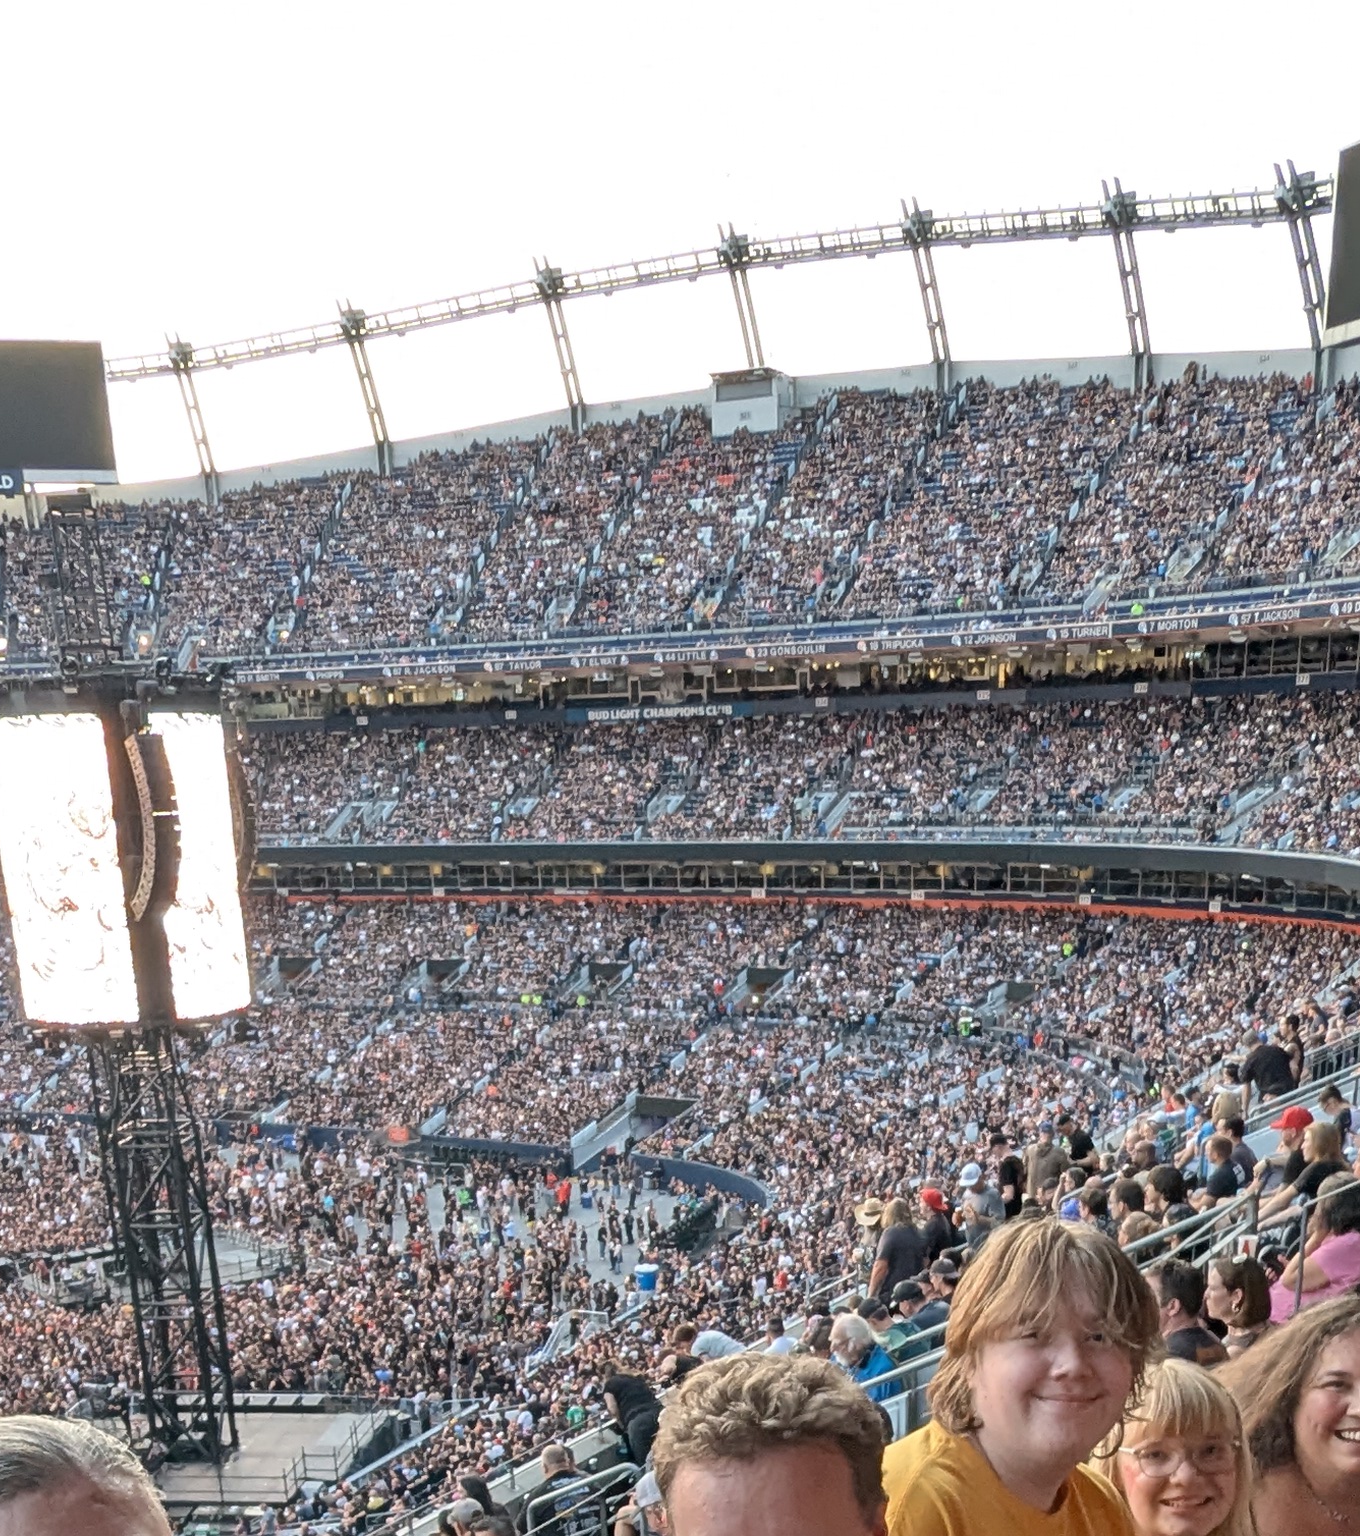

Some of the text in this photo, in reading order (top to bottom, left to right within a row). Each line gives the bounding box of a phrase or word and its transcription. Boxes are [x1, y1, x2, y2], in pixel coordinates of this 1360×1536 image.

[1341, 602, 1353, 613] 49
[1241, 615, 1252, 625] 57
[1261, 608, 1301, 622] JACKSON
[1156, 619, 1199, 631] MORTON
[1072, 626, 1109, 638] TURNER
[964, 632, 1017, 644] 12 JOHNSON
[677, 650, 707, 661] LITTLE
[757, 648, 768, 657] 23
[509, 660, 542, 671] TAYLOR
[588, 656, 618, 666] ELWAY
[414, 664, 456, 675] JACKSON
[587, 710, 609, 721] BUD
[610, 708, 640, 720] LIGHT
[643, 706, 705, 719] CHAMPIONS
